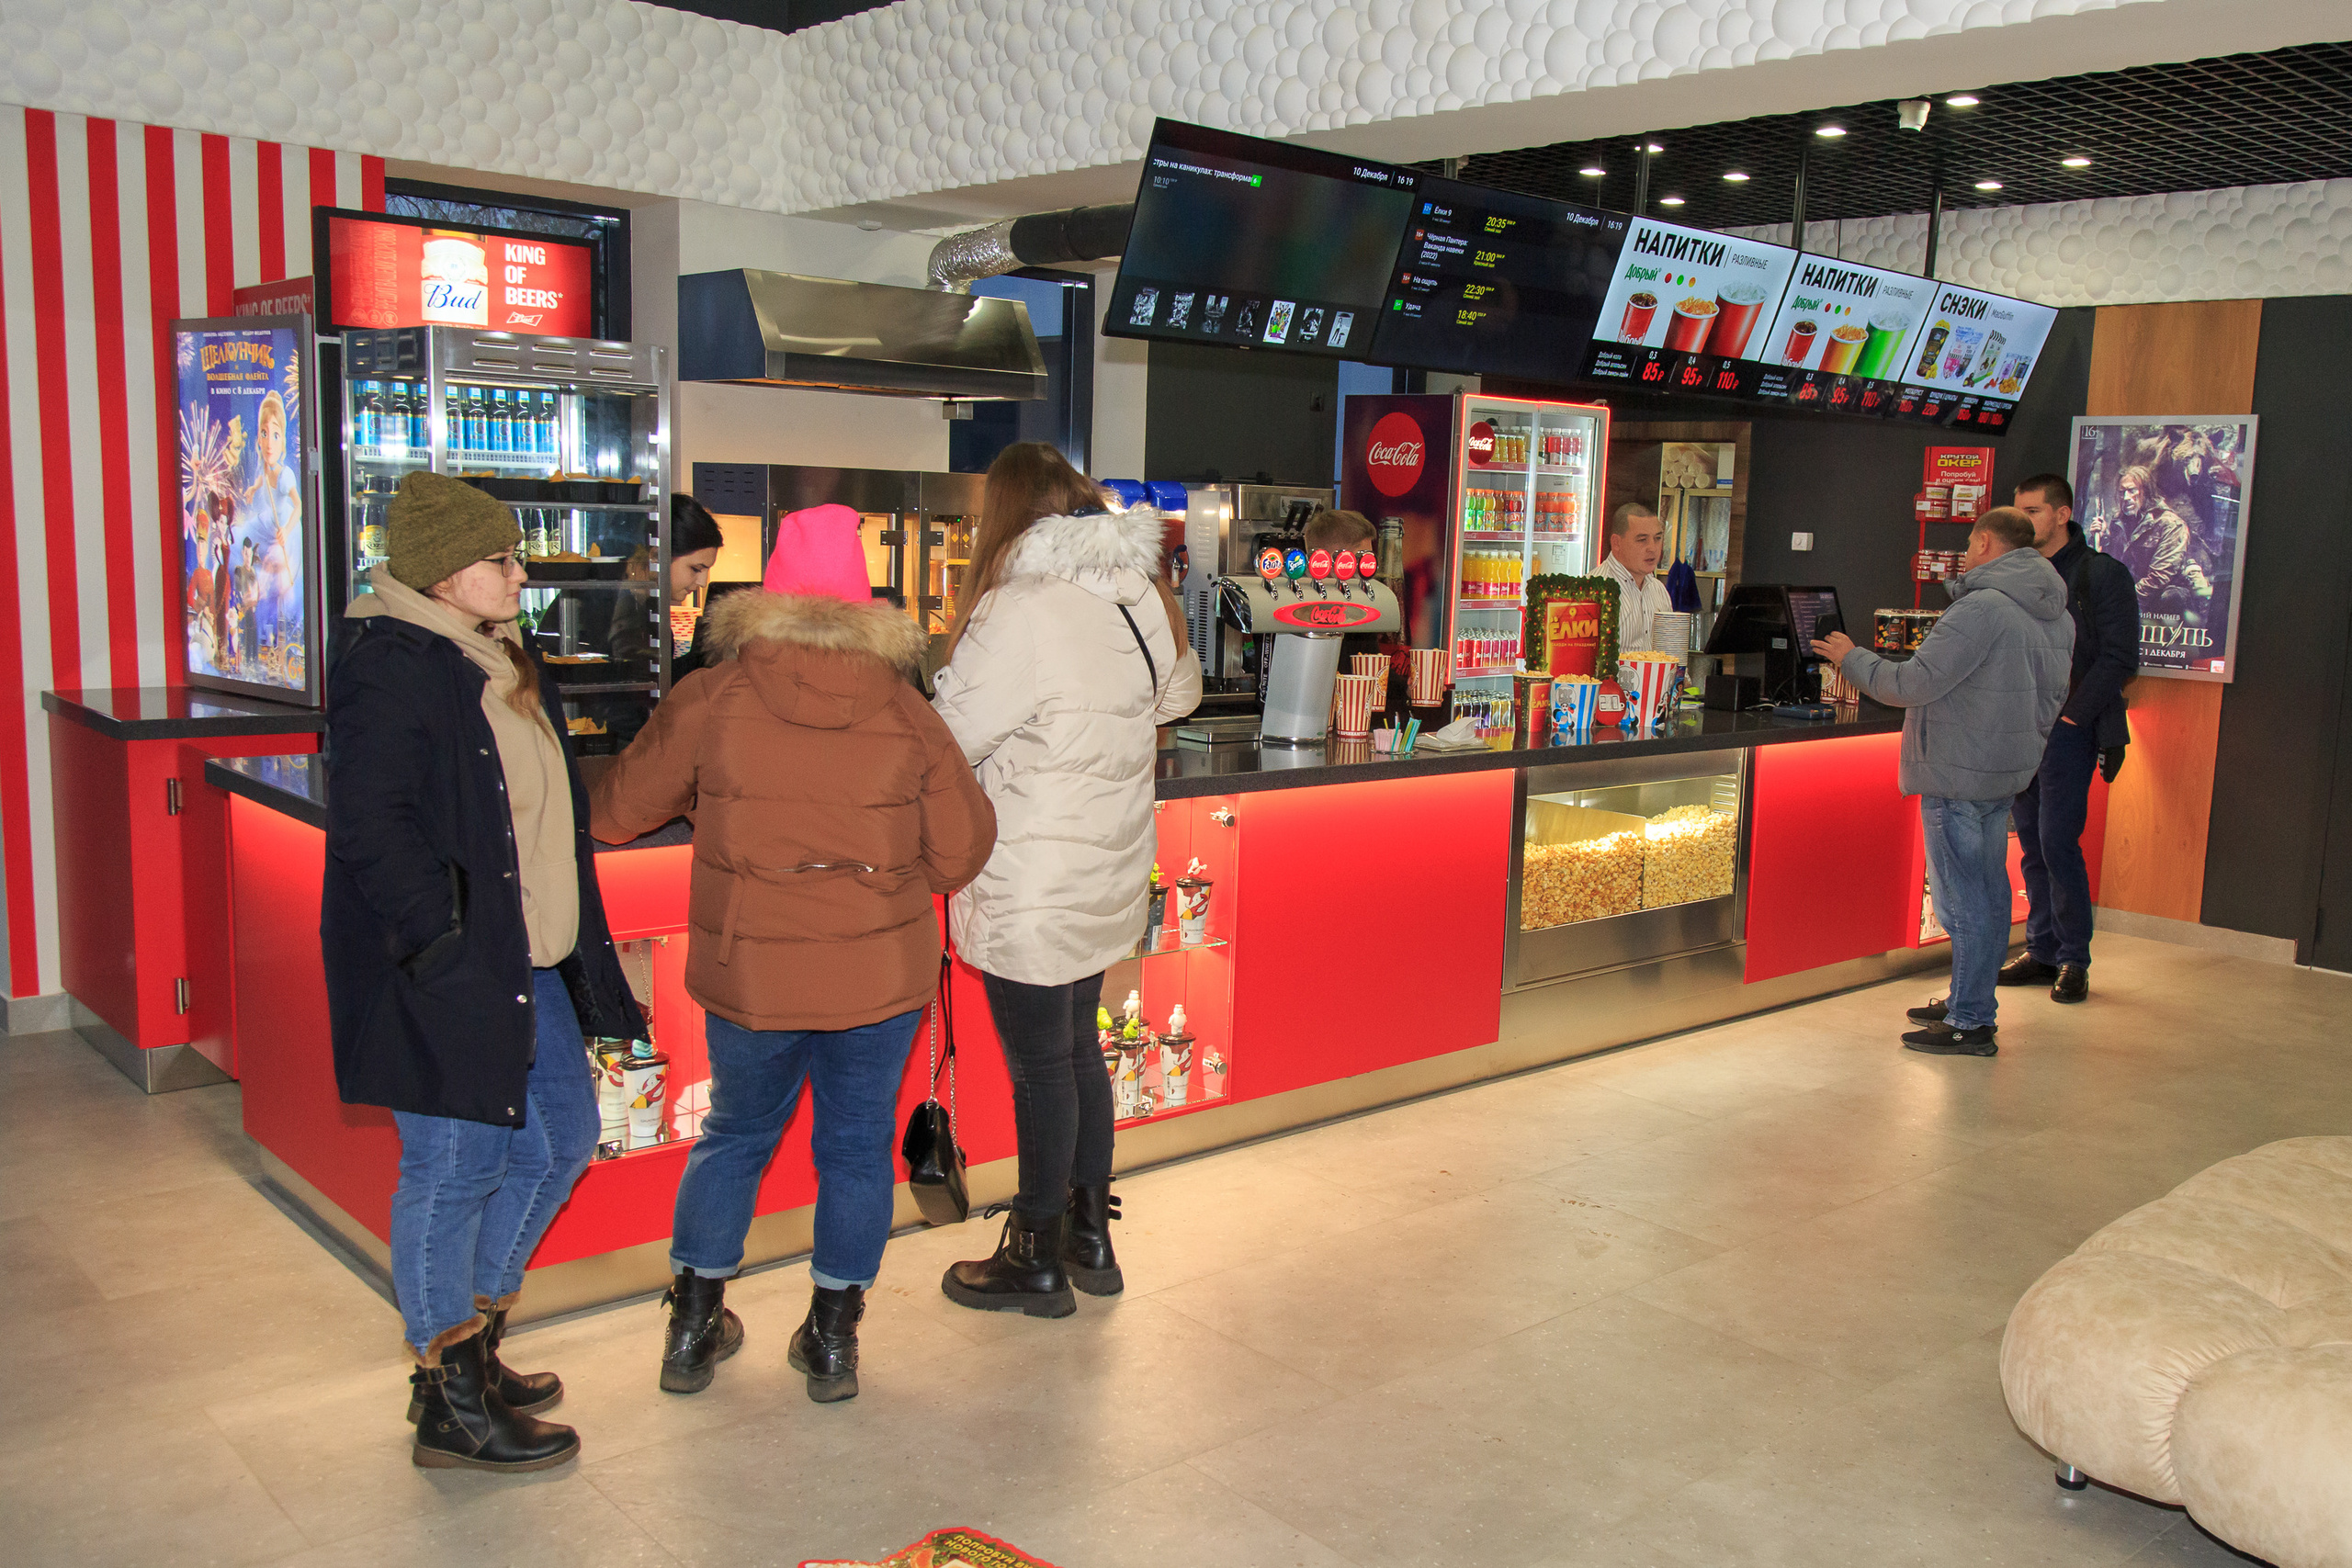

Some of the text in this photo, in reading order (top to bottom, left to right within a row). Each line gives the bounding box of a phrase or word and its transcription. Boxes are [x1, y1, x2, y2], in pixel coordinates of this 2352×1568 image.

[1154, 175, 1170, 186] 10:10
[1214, 169, 1252, 183] трансформа
[1353, 167, 1388, 182] 10 Декабря
[1486, 216, 1507, 229] 20:35
[1566, 211, 1599, 227] 10 Декабря
[505, 243, 546, 265] KING
[1634, 228, 1769, 270] НАПИТКИ РАЗЛИВНЫЕ
[1421, 251, 1438, 261] (2022)
[1476, 250, 1496, 263] 21:00
[505, 265, 526, 285] OF
[1800, 263, 1914, 300] НАПИТКИ РАЗЛИВНЫЕ
[424, 283, 482, 310] Bud
[1464, 284, 1485, 296] 22:30
[1405, 302, 1421, 311] Удача
[1939, 292, 1989, 320] СНЭКИ
[1457, 310, 1476, 321] 18:40
[200, 341, 275, 372] ЩЕЛКУНЧИК
[1649, 351, 1657, 359] 0,3
[1688, 355, 1696, 365] 0,4
[1722, 360, 1731, 369] 0,5
[207, 370, 269, 381] ВОЛШЕБНАЯ ФЛЕЙТА
[243, 387, 266, 395] ДЕКАБРЯ
[1940, 470, 1976, 479] Попробуй
[1288, 558, 1304, 571] Sprite
[2154, 613, 2180, 621] НАГИЕВ
[1549, 616, 1599, 640] ЁЛКИ
[2139, 621, 2213, 648] ЩУПЬ
[2149, 649, 2186, 658] ДЕКАБРЯ
[944, 1540, 991, 1562] НОВОГО
[954, 1535, 1016, 1564] ПОПРОБУЙ
